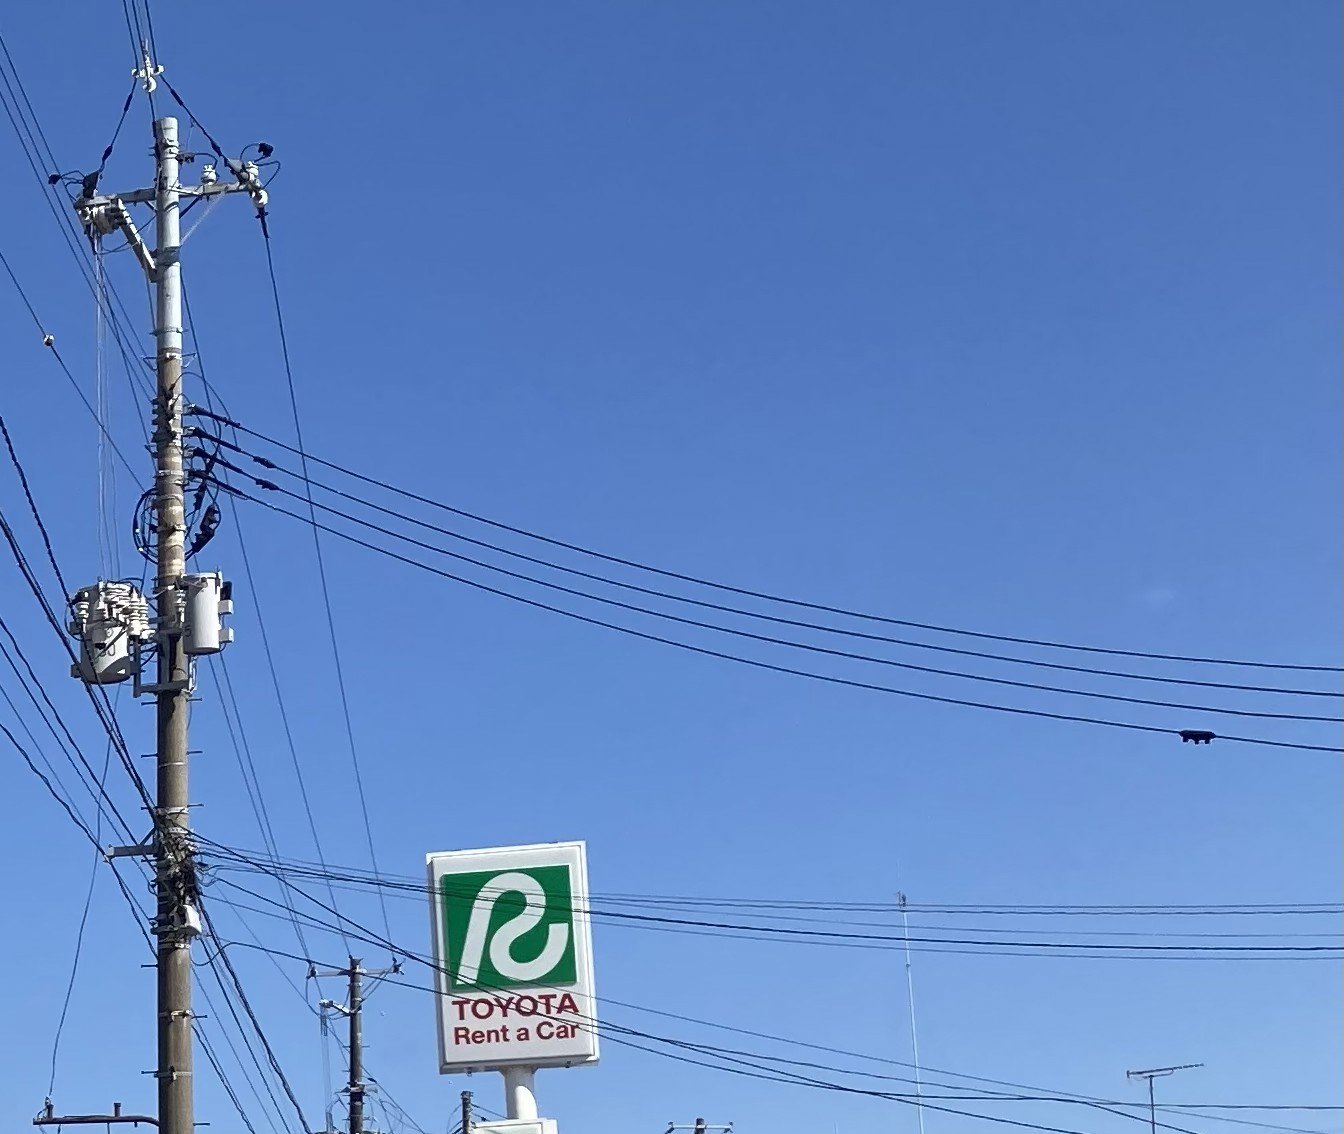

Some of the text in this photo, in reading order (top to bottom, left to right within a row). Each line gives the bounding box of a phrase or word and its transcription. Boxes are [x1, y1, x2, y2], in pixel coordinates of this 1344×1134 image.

[451, 993, 580, 1020] TOYOTA
[454, 1021, 580, 1045] Rent a Car
